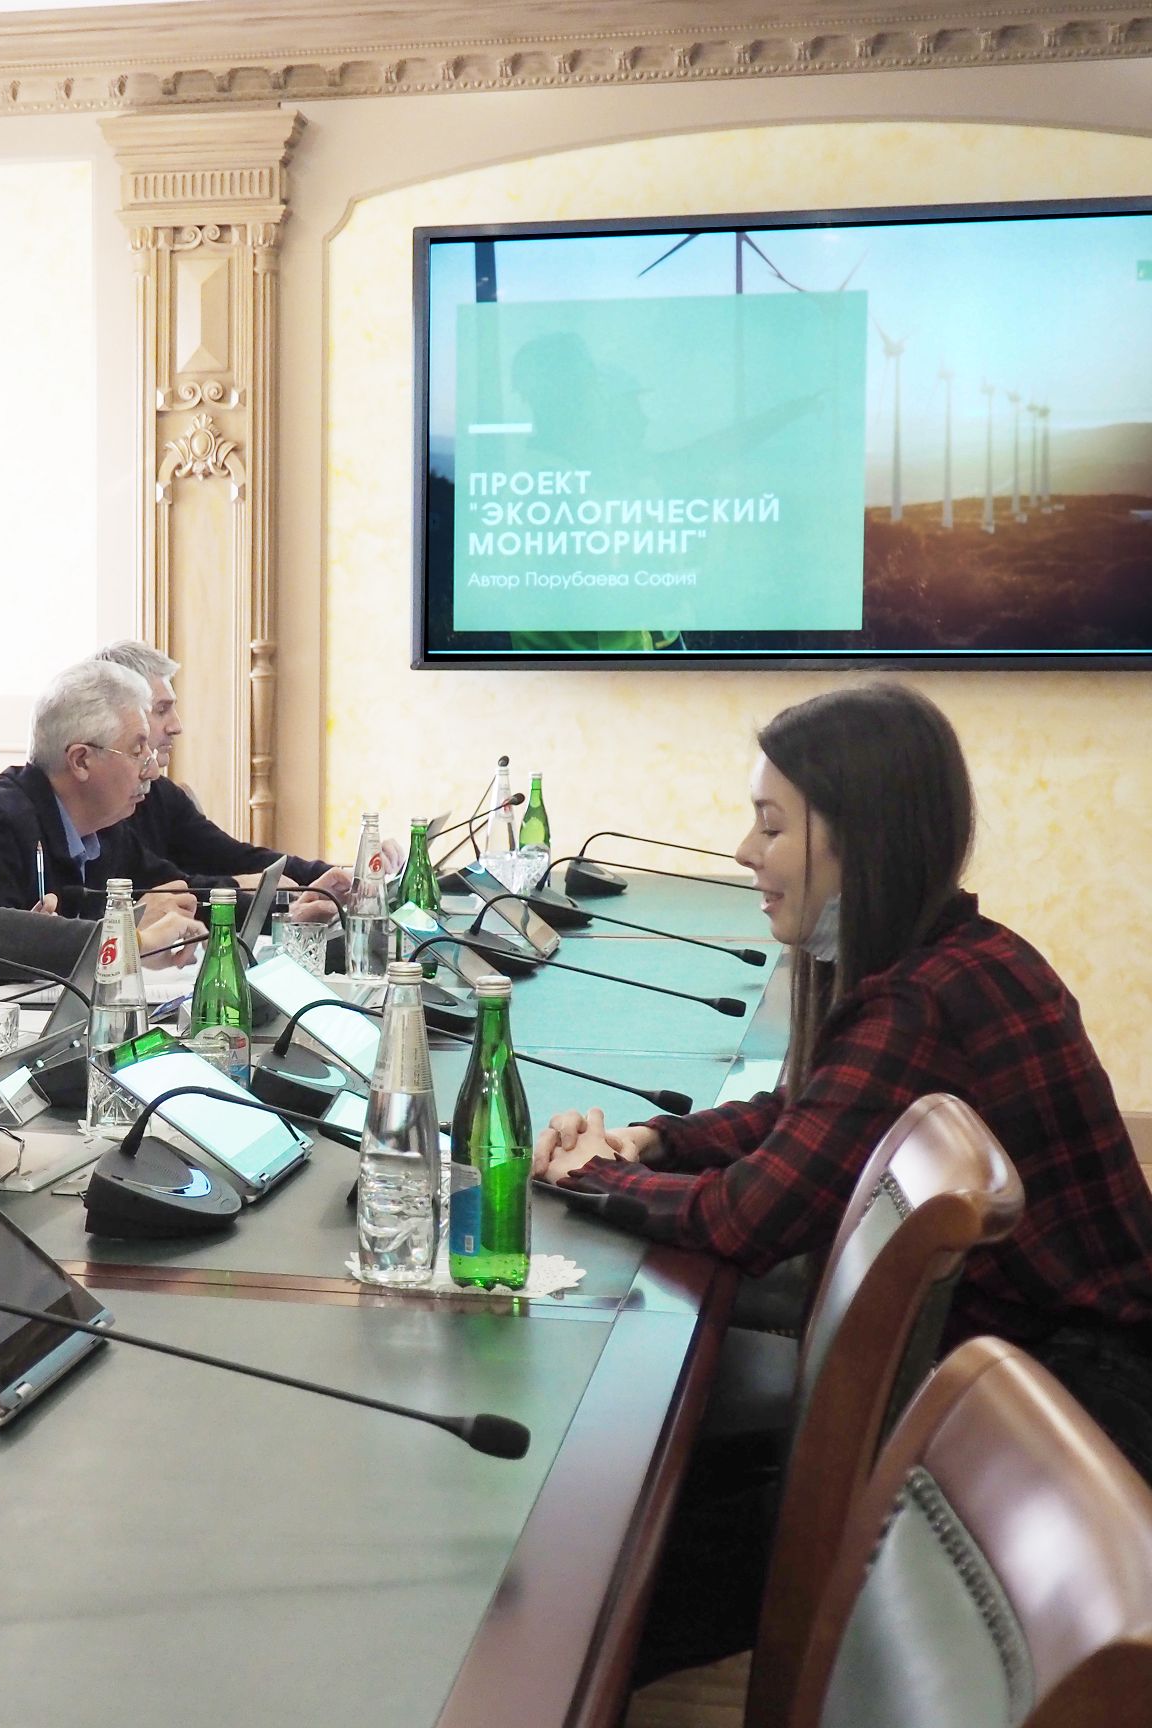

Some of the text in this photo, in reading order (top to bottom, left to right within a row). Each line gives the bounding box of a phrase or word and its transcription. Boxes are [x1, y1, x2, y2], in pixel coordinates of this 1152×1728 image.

[469, 471, 591, 496] ПРОЕКТ
[469, 493, 780, 526] "ЭКОЛОГИЧЕСКИЙ
[469, 530, 706, 556] МОНИТОРИНГ"
[467, 570, 697, 589] Автор Порубаева София
